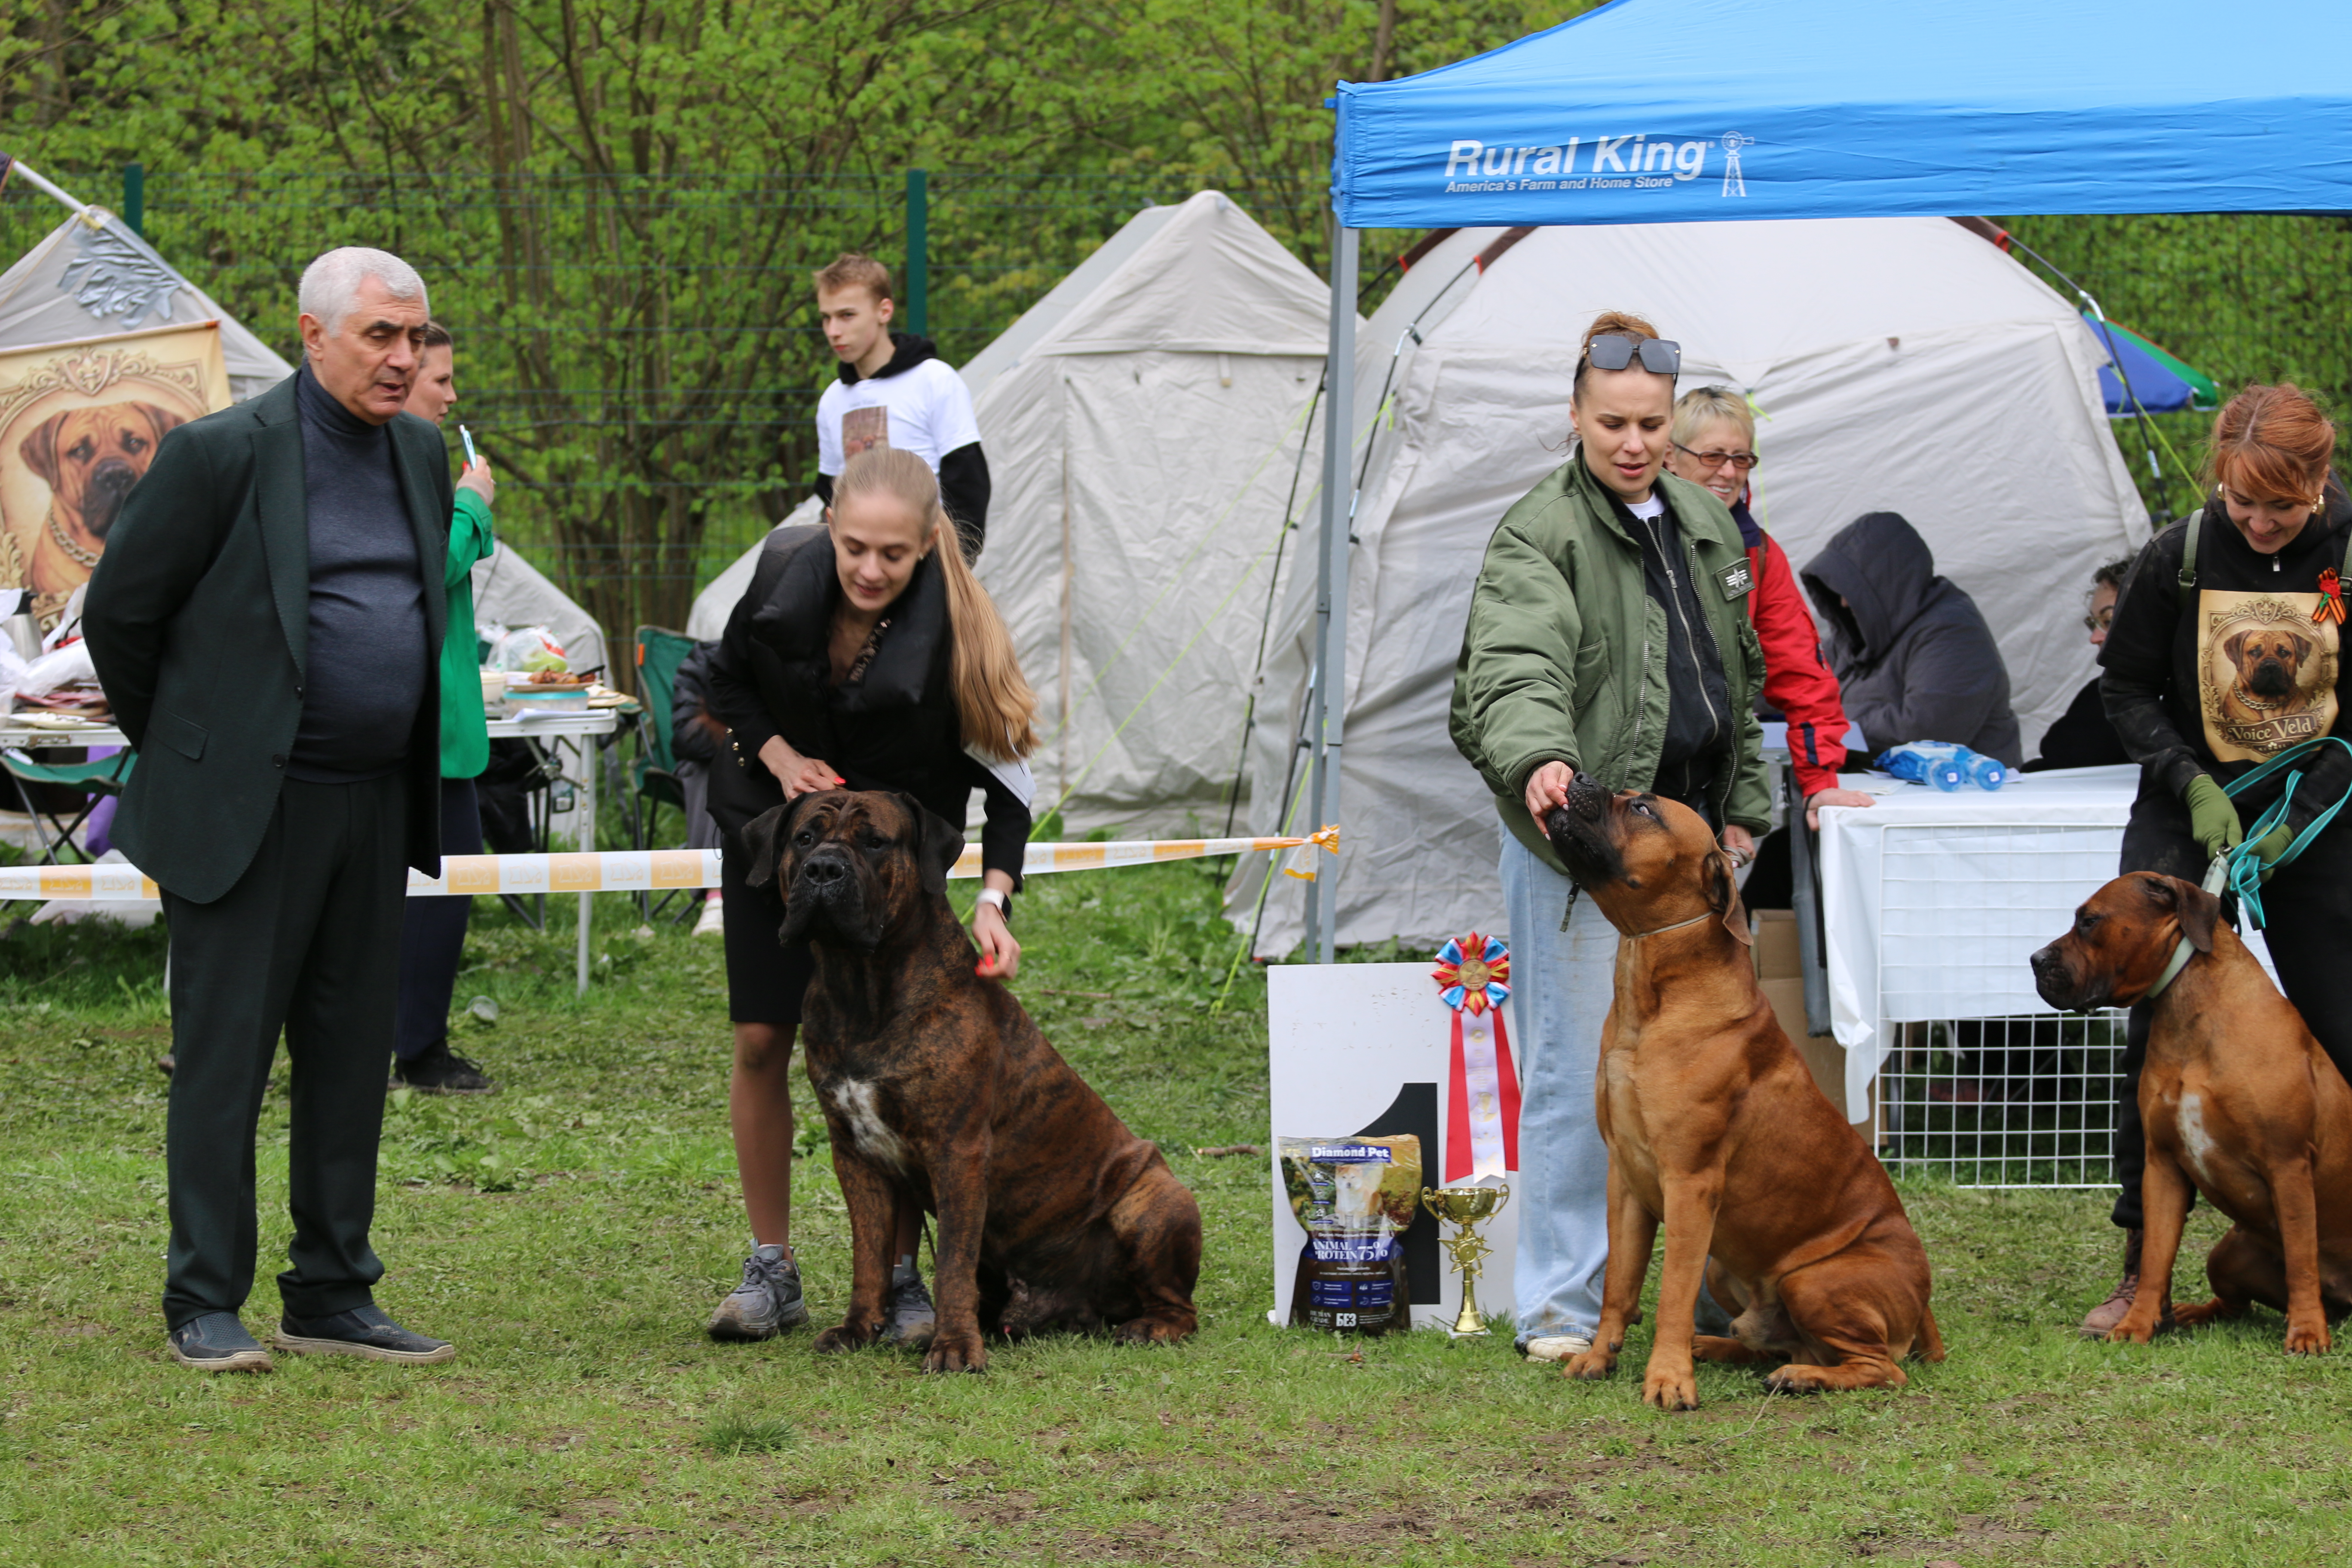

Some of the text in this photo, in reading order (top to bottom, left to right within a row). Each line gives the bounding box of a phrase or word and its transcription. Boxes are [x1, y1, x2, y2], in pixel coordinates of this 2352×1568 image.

[1444, 134, 1707, 181] Rural King
[1445, 176, 1672, 193] America's Farm and Home Store
[2227, 717, 2312, 740] Voice Veld
[1312, 1146, 1389, 1157] Diamond Pet
[1357, 1241, 1388, 1261] 75%
[1336, 1313, 1357, 1327] БЕЗ
